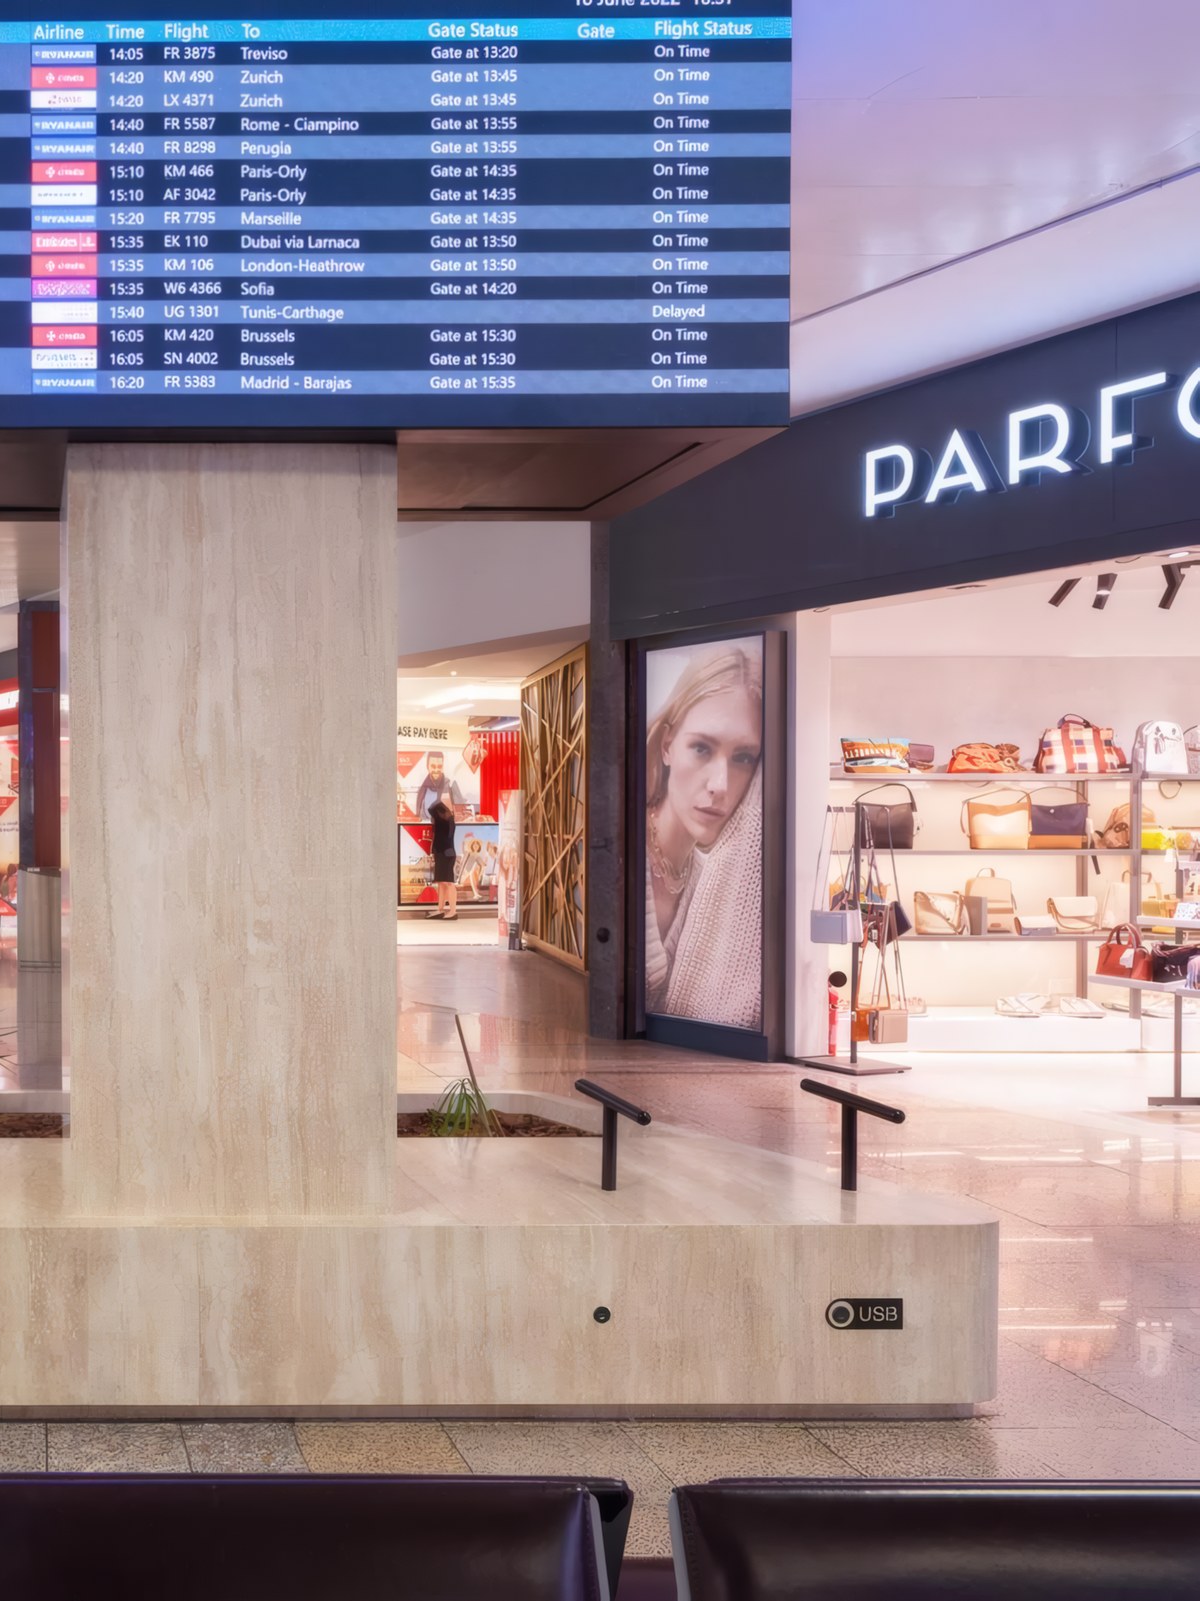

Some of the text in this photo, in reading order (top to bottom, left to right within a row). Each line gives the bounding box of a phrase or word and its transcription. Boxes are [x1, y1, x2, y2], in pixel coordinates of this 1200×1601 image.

[34, 20, 752, 42] Airline Time Flight To Gate Status Gate Flight Status
[110, 44, 710, 60] 14:05 FR 3875 Treviso Gate at 13:20 On Time
[110, 142, 144, 154] 14:40
[164, 141, 180, 153] FR
[184, 141, 216, 153] 8298
[241, 141, 292, 158] Perugia
[431, 141, 462, 153] Gate
[465, 142, 478, 153] at
[483, 141, 517, 153] 13:55
[653, 140, 673, 152] On
[677, 140, 709, 152] Time
[110, 236, 144, 248] 15:35
[164, 235, 180, 247] EK
[185, 235, 208, 247] 110
[241, 235, 281, 249] Dubai
[284, 235, 304, 248] via
[308, 236, 360, 249] Larnaca
[431, 235, 461, 248] Gate
[465, 237, 477, 248] at
[483, 235, 517, 247] 13:50
[653, 235, 673, 247] On
[676, 234, 708, 246] Time
[110, 258, 708, 272] 15:35 KM 106 London-Heathrow Gate at 13:50 On Time
[110, 281, 708, 296] 15:35 W6 4366 Sofia Gate at 14:20 On Time
[110, 328, 708, 342] 16:05 KM 420 Brussels Gate at 15:30 On Time
[413, 727, 428, 738] PAY
[429, 728, 448, 740] HERE
[859, 1306, 898, 1322] USB
